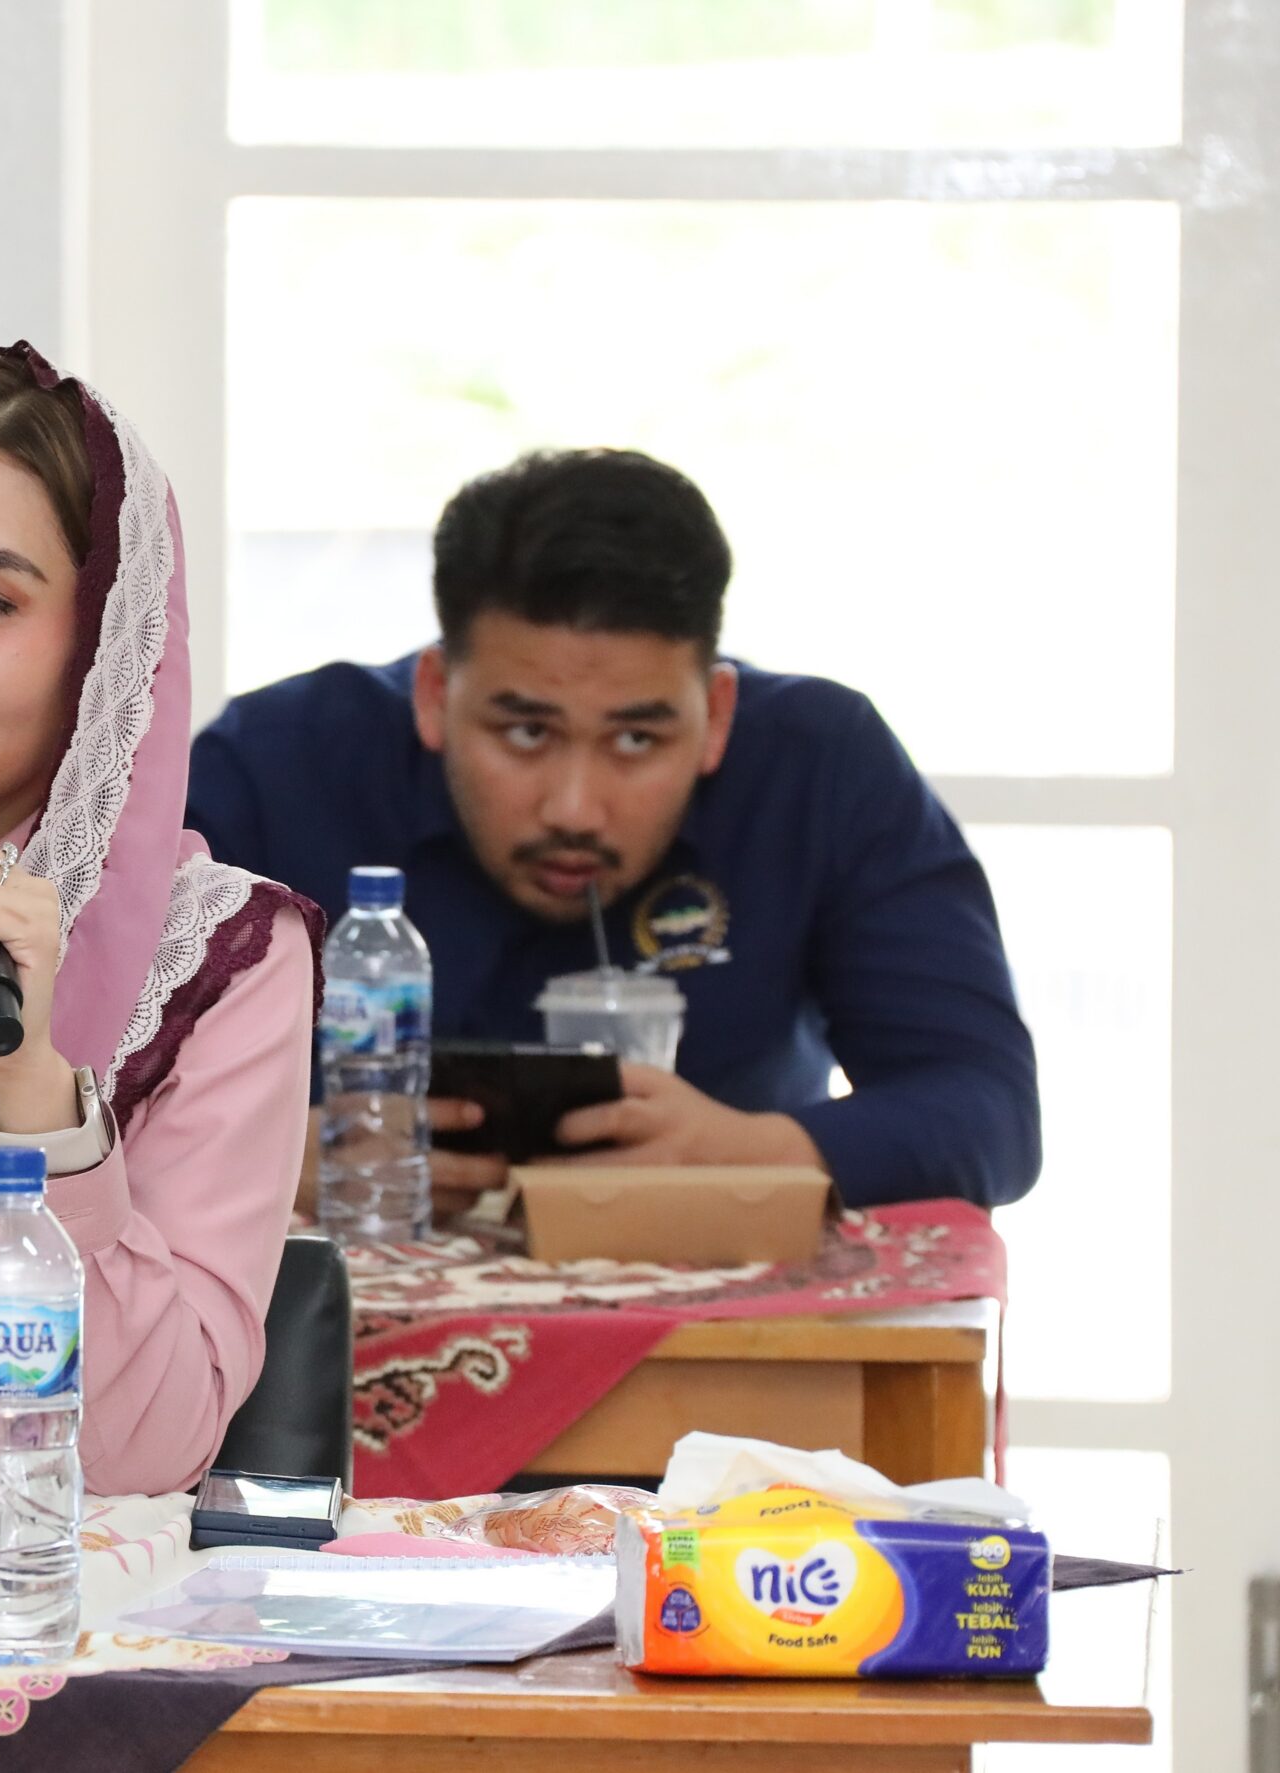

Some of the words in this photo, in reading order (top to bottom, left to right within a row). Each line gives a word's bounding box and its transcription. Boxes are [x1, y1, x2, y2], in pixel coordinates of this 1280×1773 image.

[760, 1500, 812, 1517] Food
[977, 1573, 1004, 1582] lebih
[967, 1583, 1013, 1598] KUAT,
[973, 1602, 1003, 1612] lebih
[955, 1613, 1019, 1631] TEBAL,
[769, 1633, 803, 1647] Food
[807, 1633, 838, 1647] Safe
[971, 1635, 998, 1644] lebih
[967, 1644, 1001, 1659] FUN
